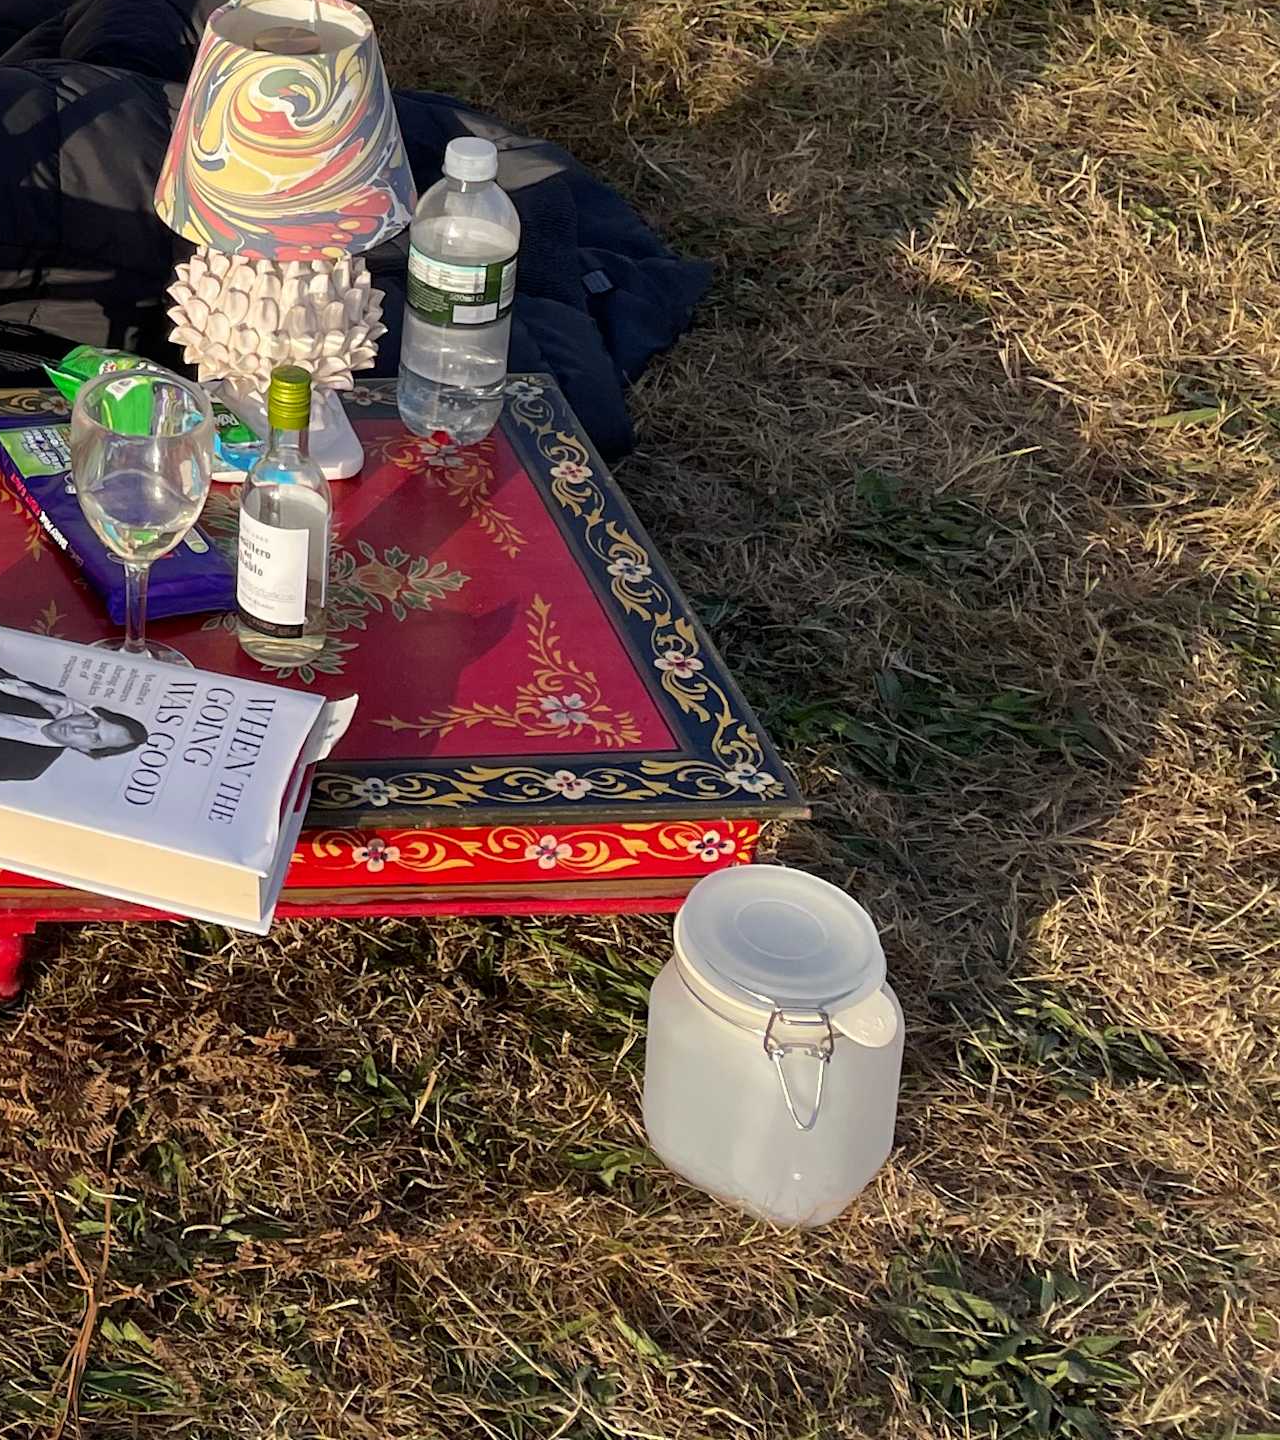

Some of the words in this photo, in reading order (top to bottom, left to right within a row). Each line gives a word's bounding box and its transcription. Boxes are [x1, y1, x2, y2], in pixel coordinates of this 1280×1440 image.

[154, 682, 198, 726] WAS
[183, 687, 235, 767] GOING
[223, 698, 277, 778] WHEN
[124, 732, 176, 805] GOOD
[208, 782, 244, 824] THE
